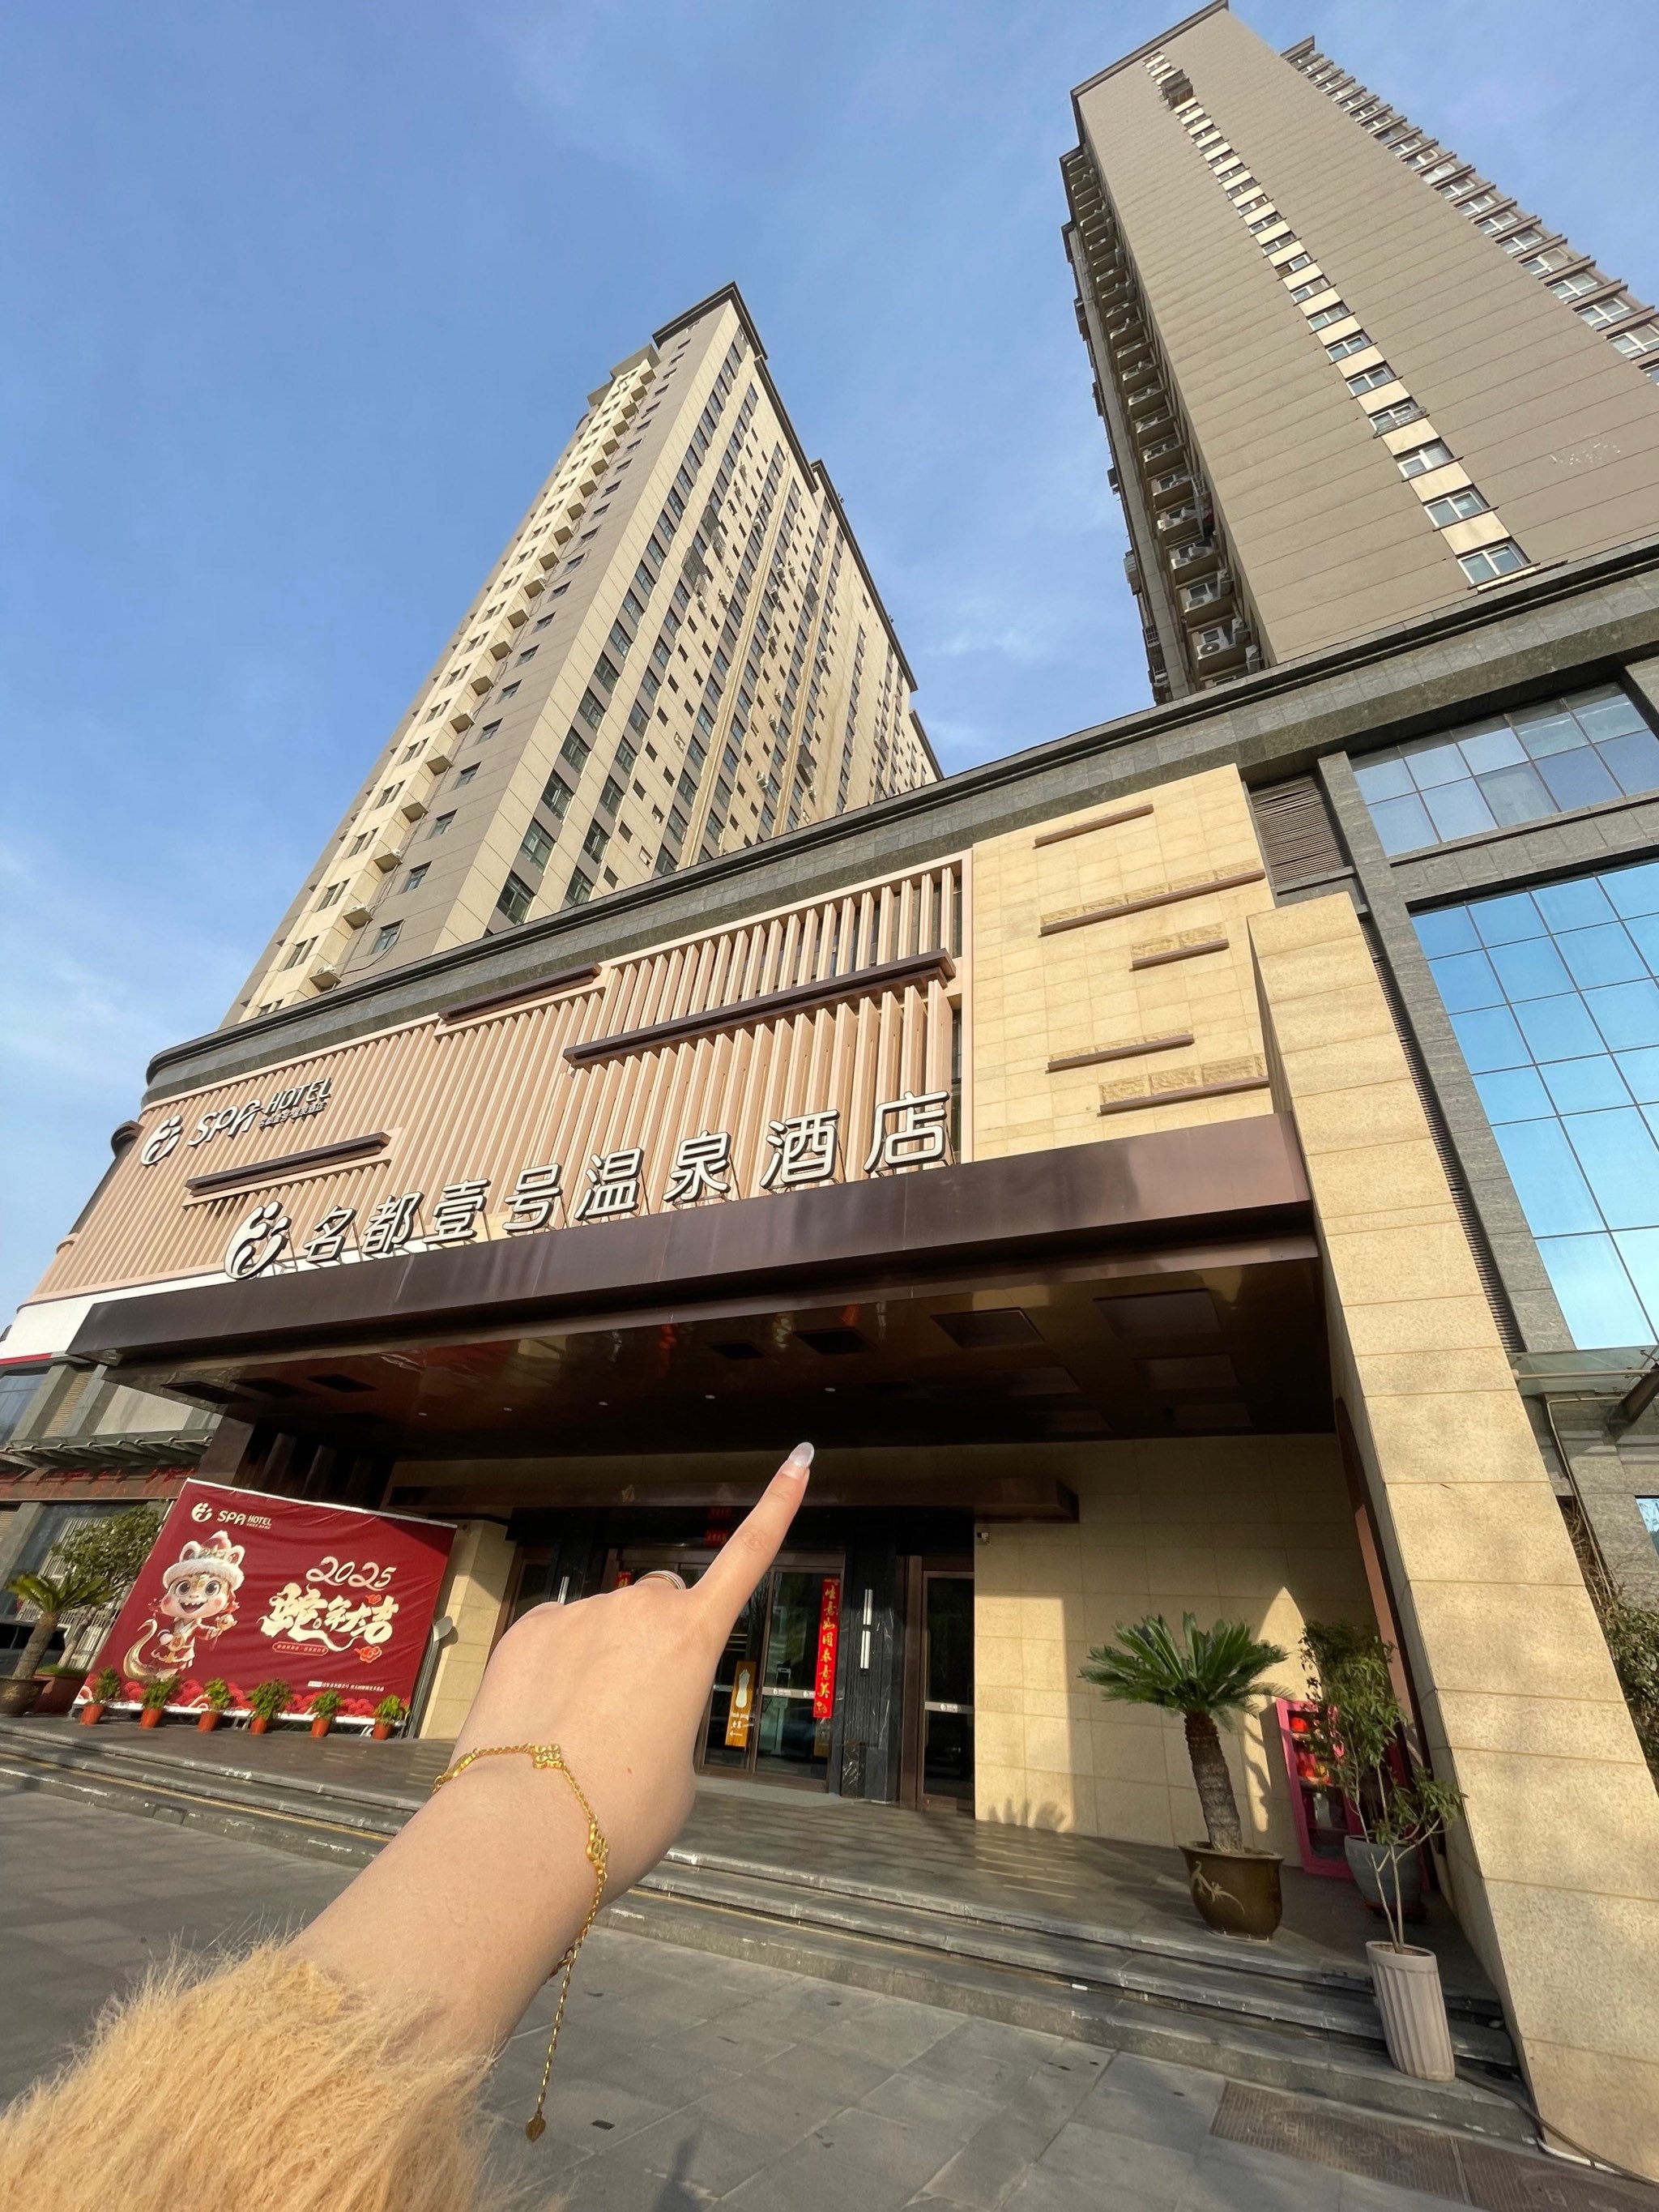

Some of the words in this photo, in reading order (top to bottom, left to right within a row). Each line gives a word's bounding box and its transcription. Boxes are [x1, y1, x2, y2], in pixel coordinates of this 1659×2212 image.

[187, 1100, 263, 1147] SPA
[265, 1078, 331, 1113] HOTEL
[304, 1091, 949, 1264] 名都壹号温泉酒店
[217, 1510, 246, 1525] SPA
[247, 1514, 272, 1527] HOTEL
[305, 1556, 397, 1591] 2025
[257, 1582, 399, 1652] 蛇年大吉
